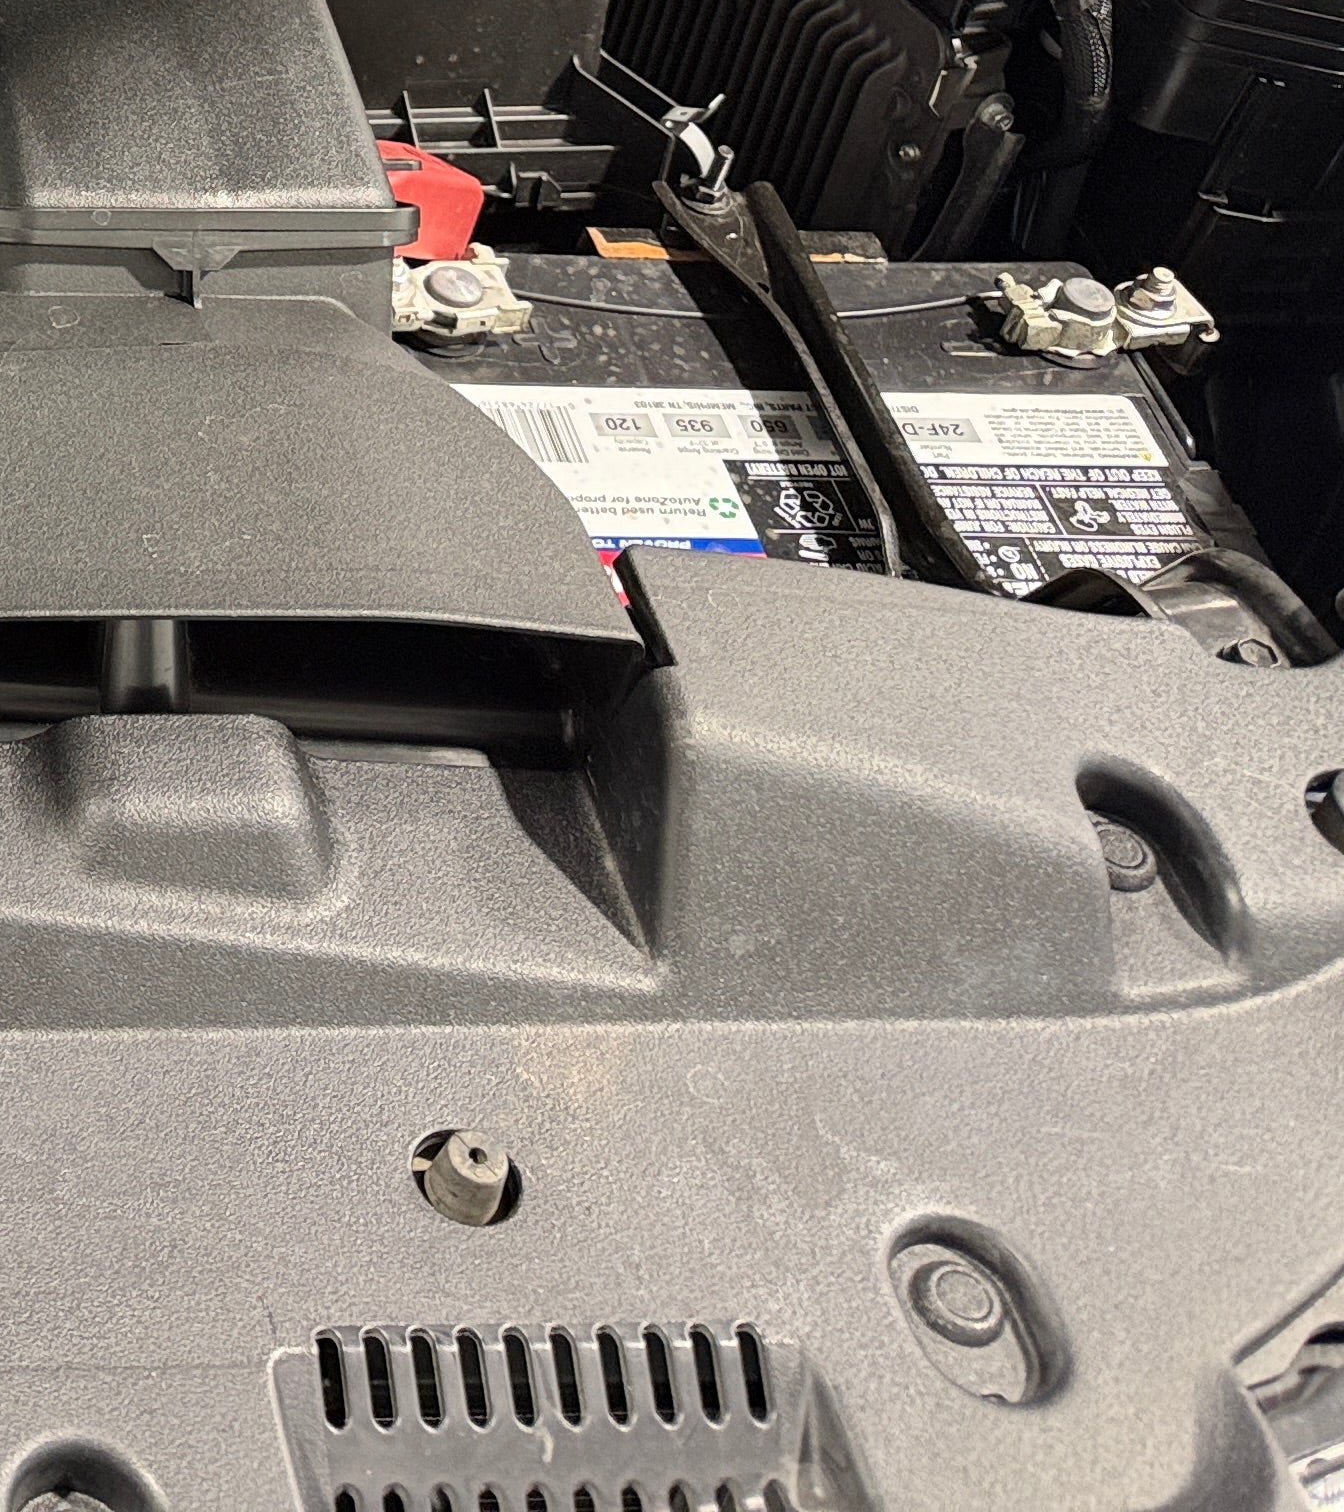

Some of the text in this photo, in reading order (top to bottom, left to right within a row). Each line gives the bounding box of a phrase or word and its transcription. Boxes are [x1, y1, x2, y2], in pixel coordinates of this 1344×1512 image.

[667, 401, 680, 410] TN
[604, 417, 642, 432] 120
[675, 419, 714, 433] 935
[749, 419, 788, 434] 650
[613, 437, 649, 446] Capacity
[919, 443, 953, 452] Number
[618, 446, 651, 455] Reserve
[677, 446, 739, 456] Cranking Amps
[932, 452, 950, 460] Part
[798, 463, 826, 475] OPEN
[1003, 466, 1018, 480] OF
[1019, 466, 1061, 481] REACH
[1057, 467, 1084, 481] THE
[1087, 467, 1102, 482] OF
[1104, 468, 1130, 482] OUT
[1131, 469, 1162, 482] KEEP
[611, 495, 630, 505] for
[1150, 487, 1172, 500] GET
[633, 496, 702, 507] AutoZone
[621, 506, 655, 516] used
[658, 507, 707, 517] Return
[1097, 554, 1162, 569] EXPLOSIVE
[1009, 562, 1039, 580] NO
